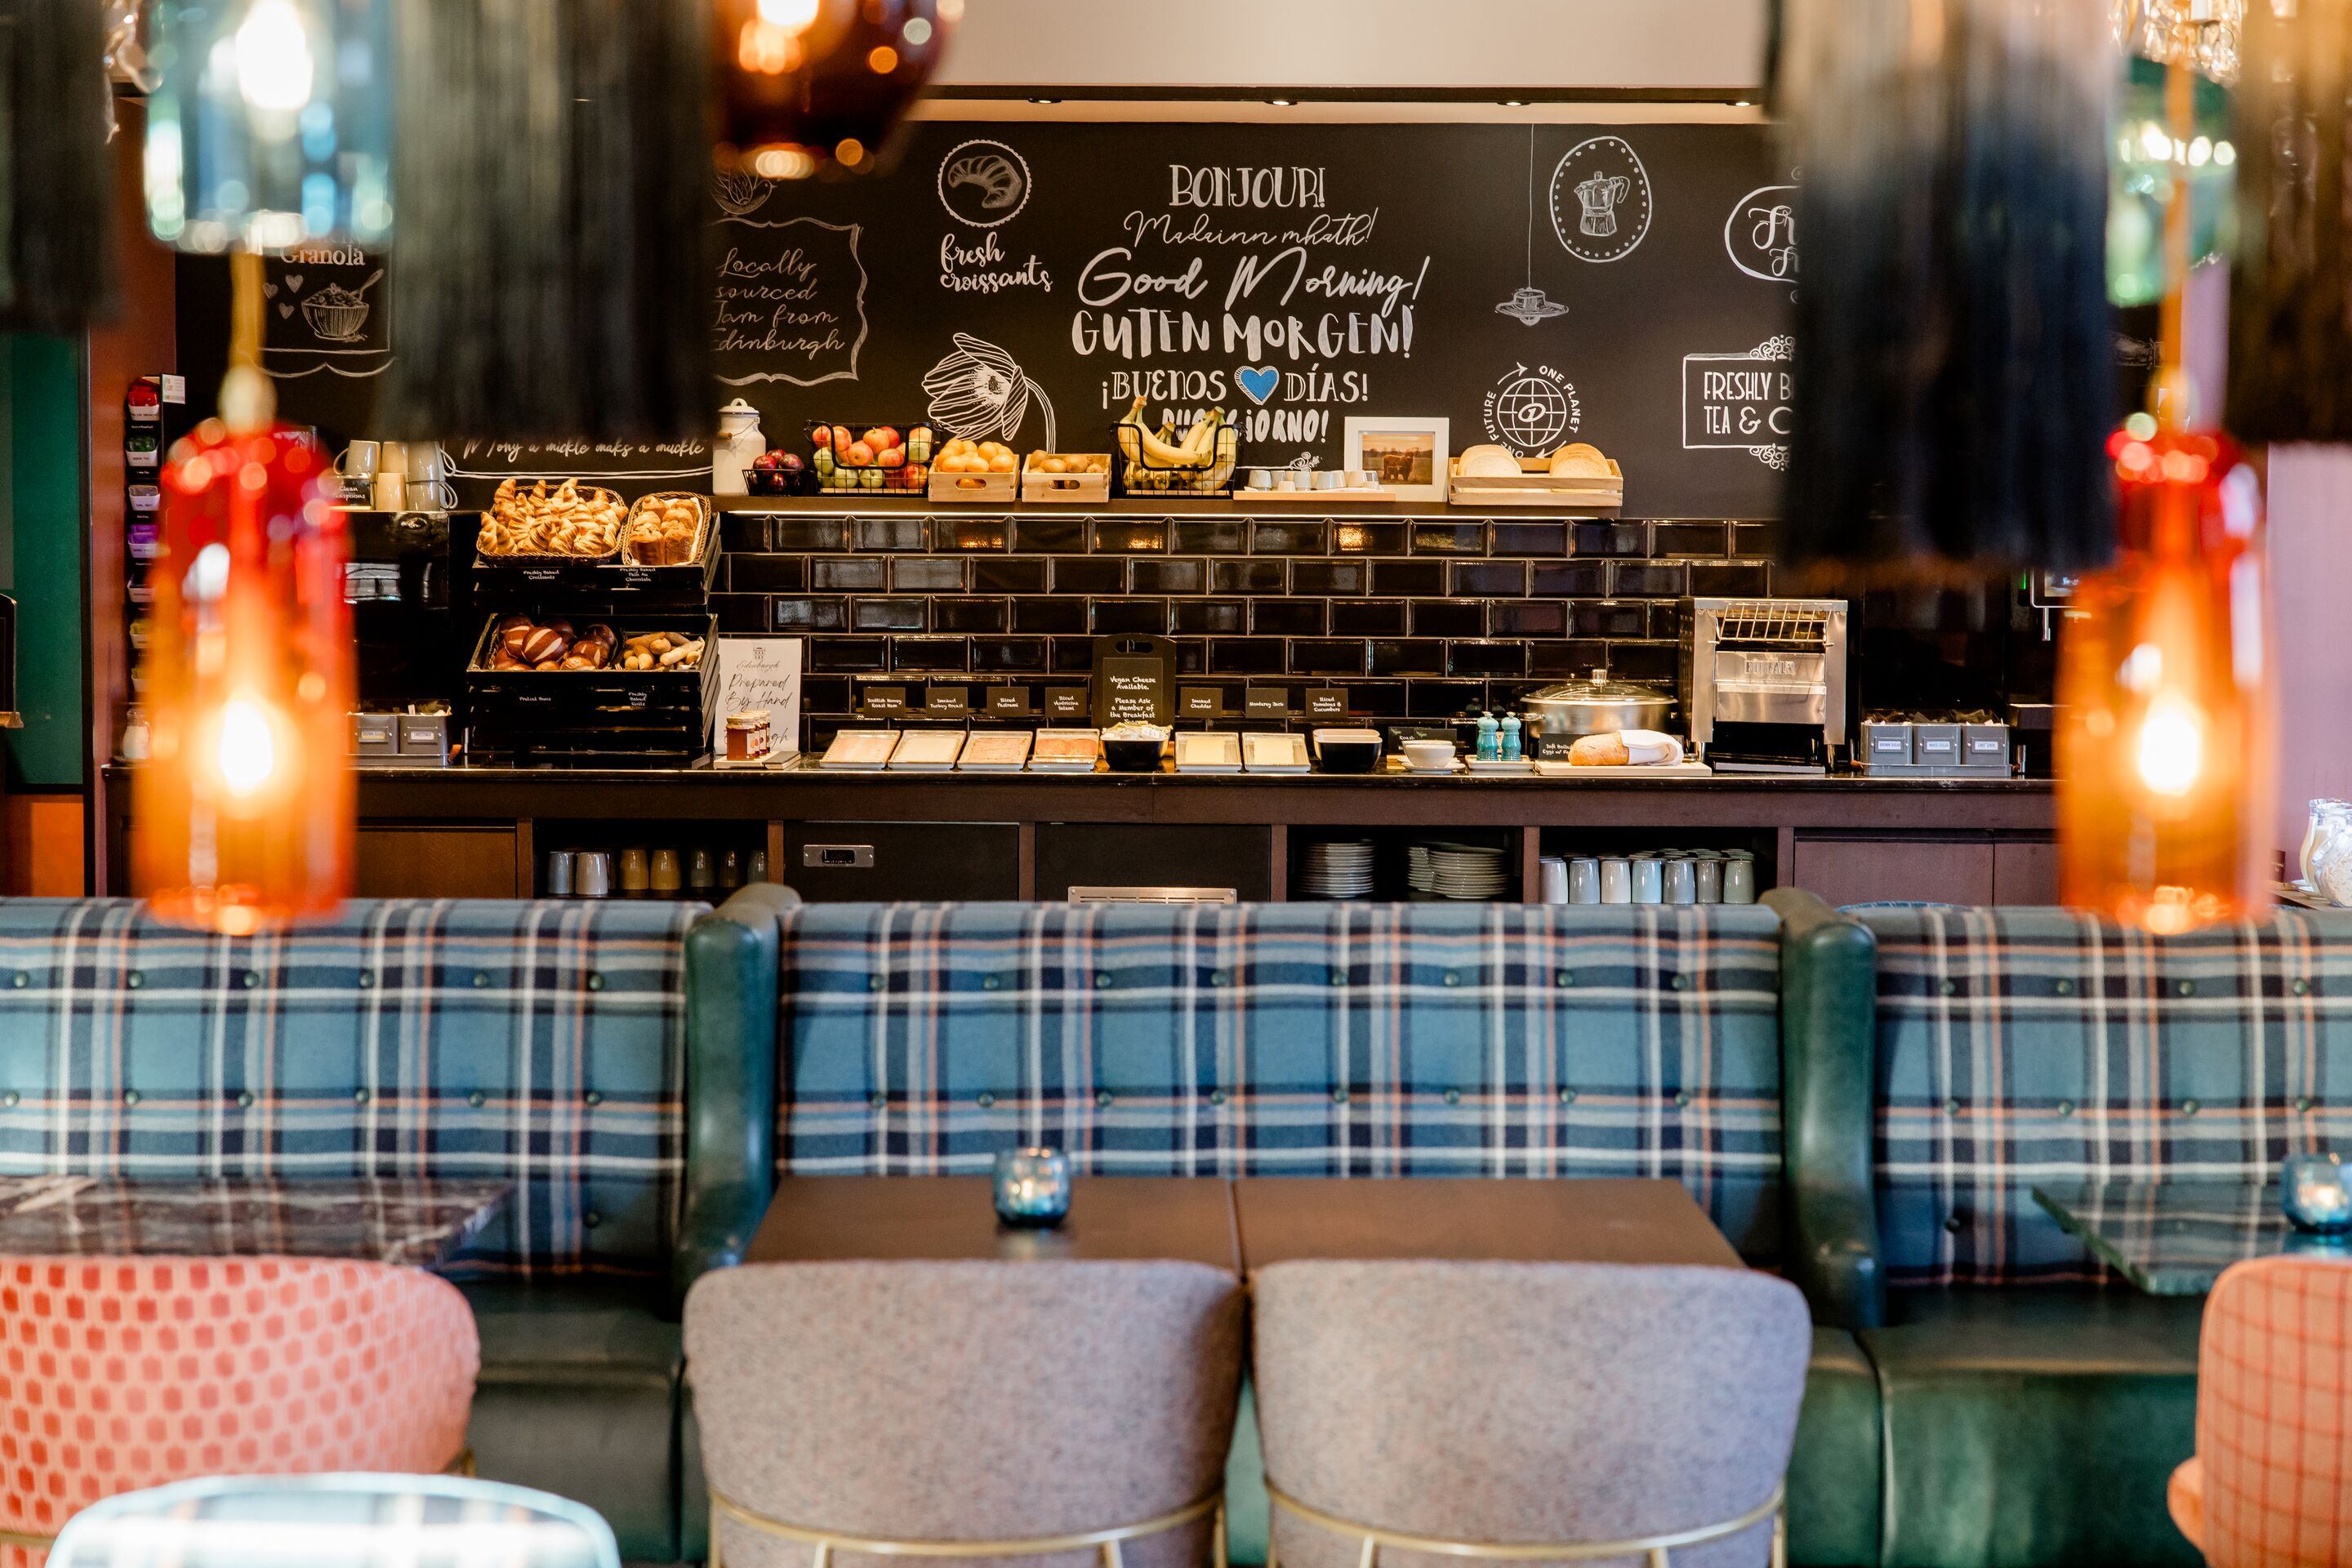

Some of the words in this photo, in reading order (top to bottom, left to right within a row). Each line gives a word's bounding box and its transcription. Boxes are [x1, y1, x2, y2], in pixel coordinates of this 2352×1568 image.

[1169, 165, 1326, 207] BONJOUR!
[1124, 210, 1277, 247] Madainn
[1281, 207, 1379, 246] mhath!
[280, 244, 366, 266] Granola
[715, 247, 817, 283] Locally
[941, 231, 1005, 274] fresh
[940, 254, 1054, 294] croissants
[1078, 247, 1209, 307] Good
[1224, 247, 1431, 318] Morning!
[715, 278, 817, 301] sourced
[711, 300, 764, 327] Jam
[773, 304, 840, 328] from
[1071, 307, 1210, 360] GUTEN
[1223, 305, 1414, 362] MORGEN!
[1102, 370, 1227, 409] ¡BUENOS
[1284, 363, 1369, 403] DÍAS!
[1539, 365, 1565, 384] ONE
[1562, 382, 1581, 434] PLANET
[1704, 372, 1772, 400] FRESHLY
[1780, 372, 1795, 400] B
[1483, 390, 1499, 442] FUTURE
[1704, 405, 1731, 434] TEA
[1739, 406, 1762, 434] &
[1768, 406, 1793, 434] C
[528, 443, 540, 452] a
[639, 445, 650, 453] a
[656, 438, 704, 457] muckle
[736, 660, 781, 674] Edinburgh
[1110, 675, 1131, 684] Vegan
[728, 673, 791, 693] Prepared
[725, 691, 751, 712] By
[755, 691, 793, 709] Hand
[1146, 703, 1155, 712] of
